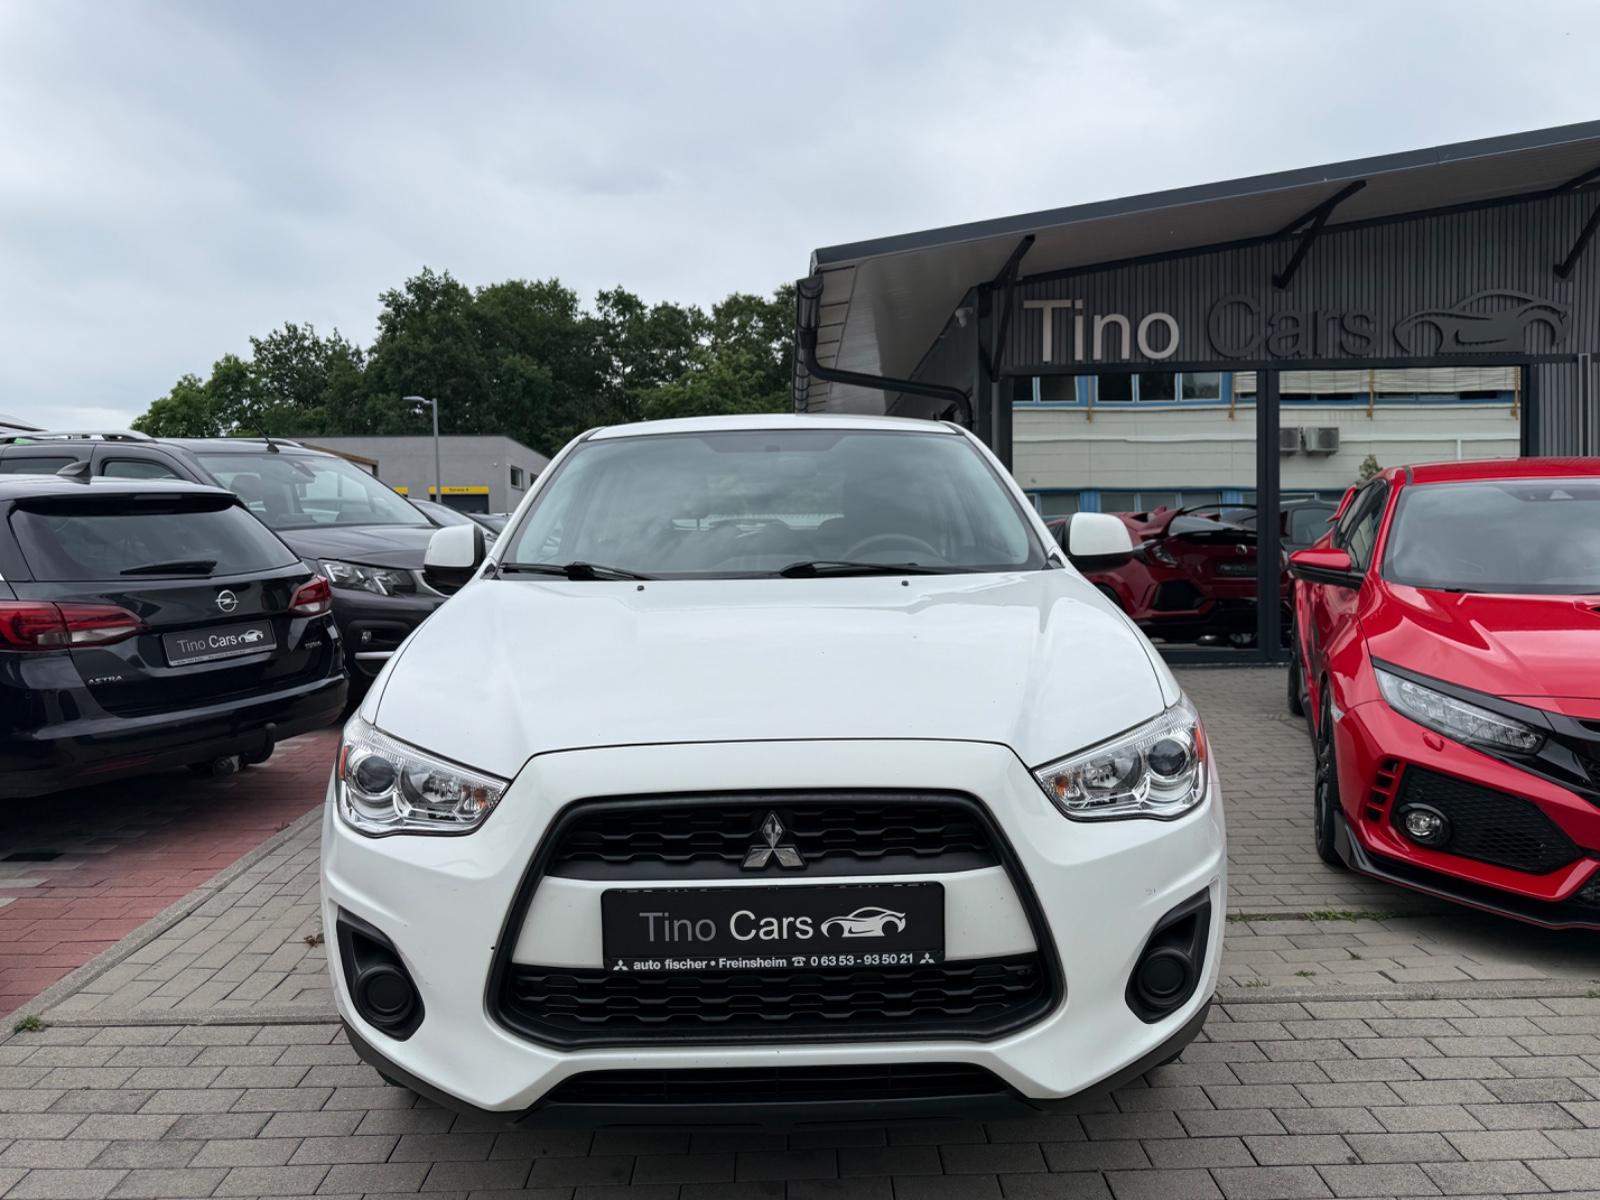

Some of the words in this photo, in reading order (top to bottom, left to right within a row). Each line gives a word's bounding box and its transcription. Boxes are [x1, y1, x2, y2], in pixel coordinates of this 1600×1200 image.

[1023, 299, 1180, 362] Tino
[1207, 296, 1377, 358] Cars
[177, 639, 206, 653] Tino
[208, 635, 238, 648] Cars
[639, 911, 717, 942] Tino
[729, 909, 814, 941] Cars
[633, 959, 661, 970] auto
[664, 958, 708, 970] fischer
[718, 957, 787, 969] Freinsheim
